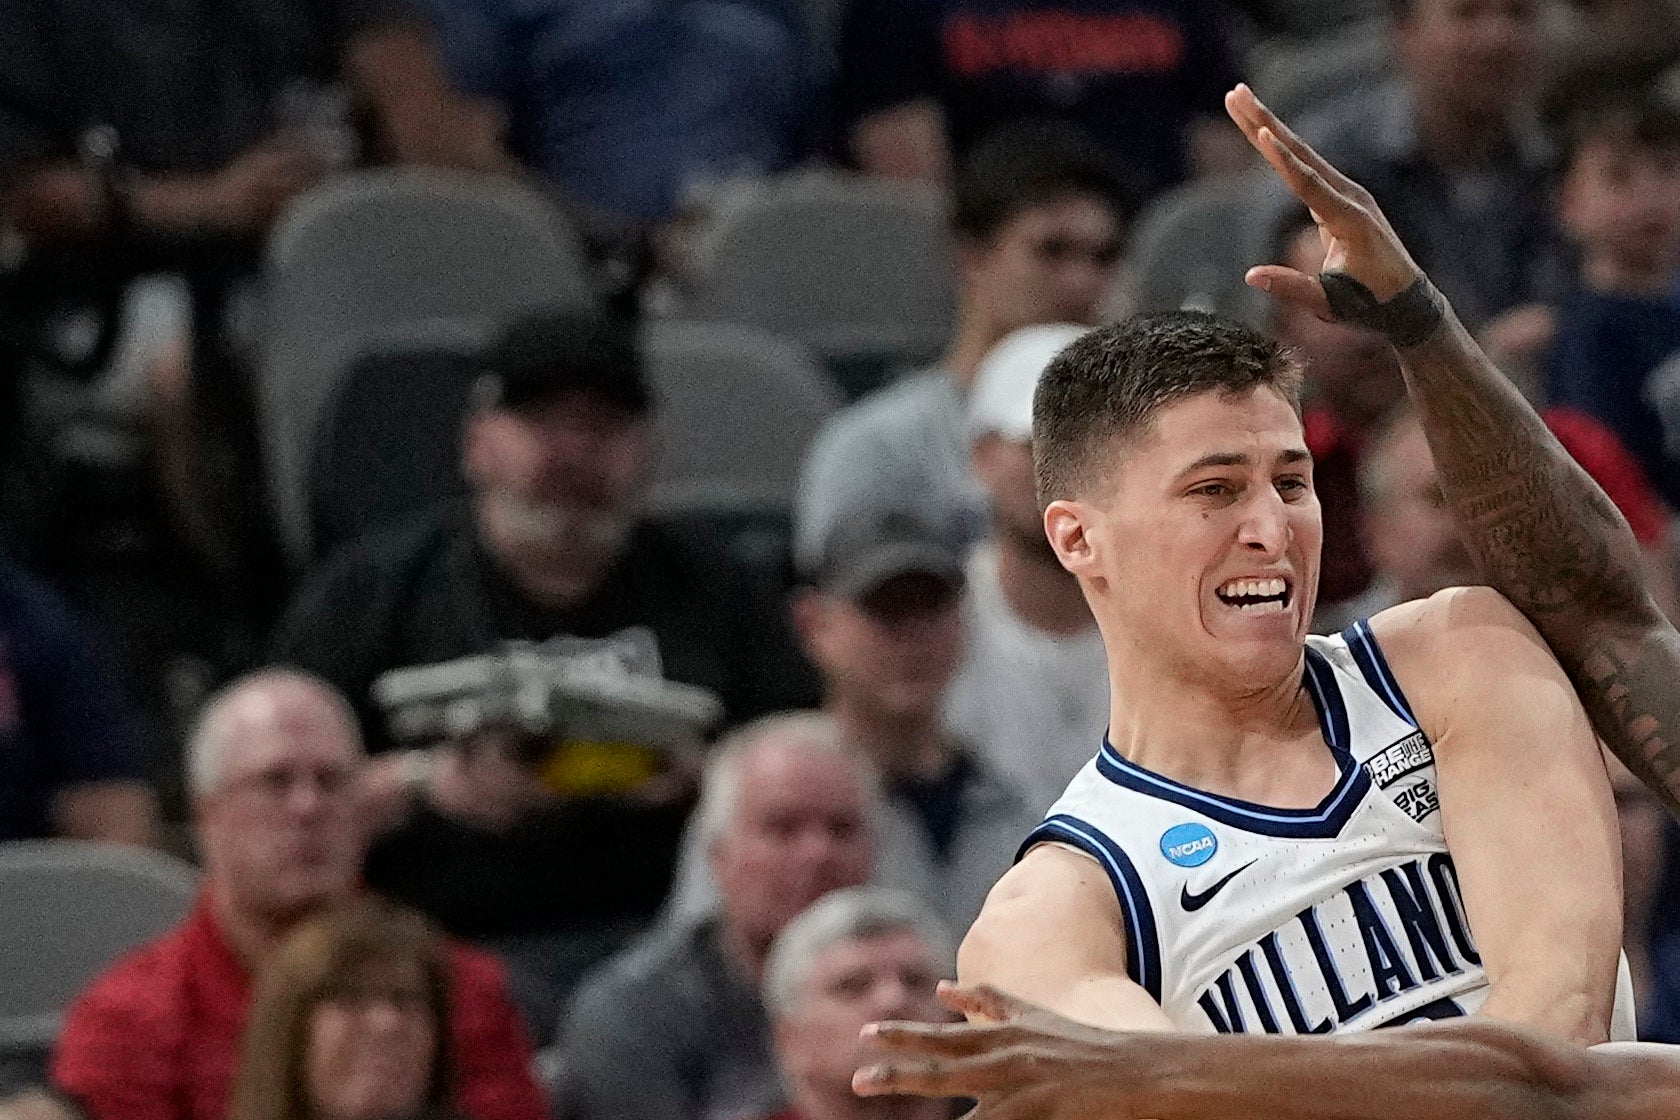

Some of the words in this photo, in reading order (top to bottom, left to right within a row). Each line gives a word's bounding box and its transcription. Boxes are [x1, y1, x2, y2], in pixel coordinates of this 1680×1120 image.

[1370, 744, 1404, 775] BE
[1375, 748, 1432, 787] HANGE
[1168, 835, 1213, 860] NCAA
